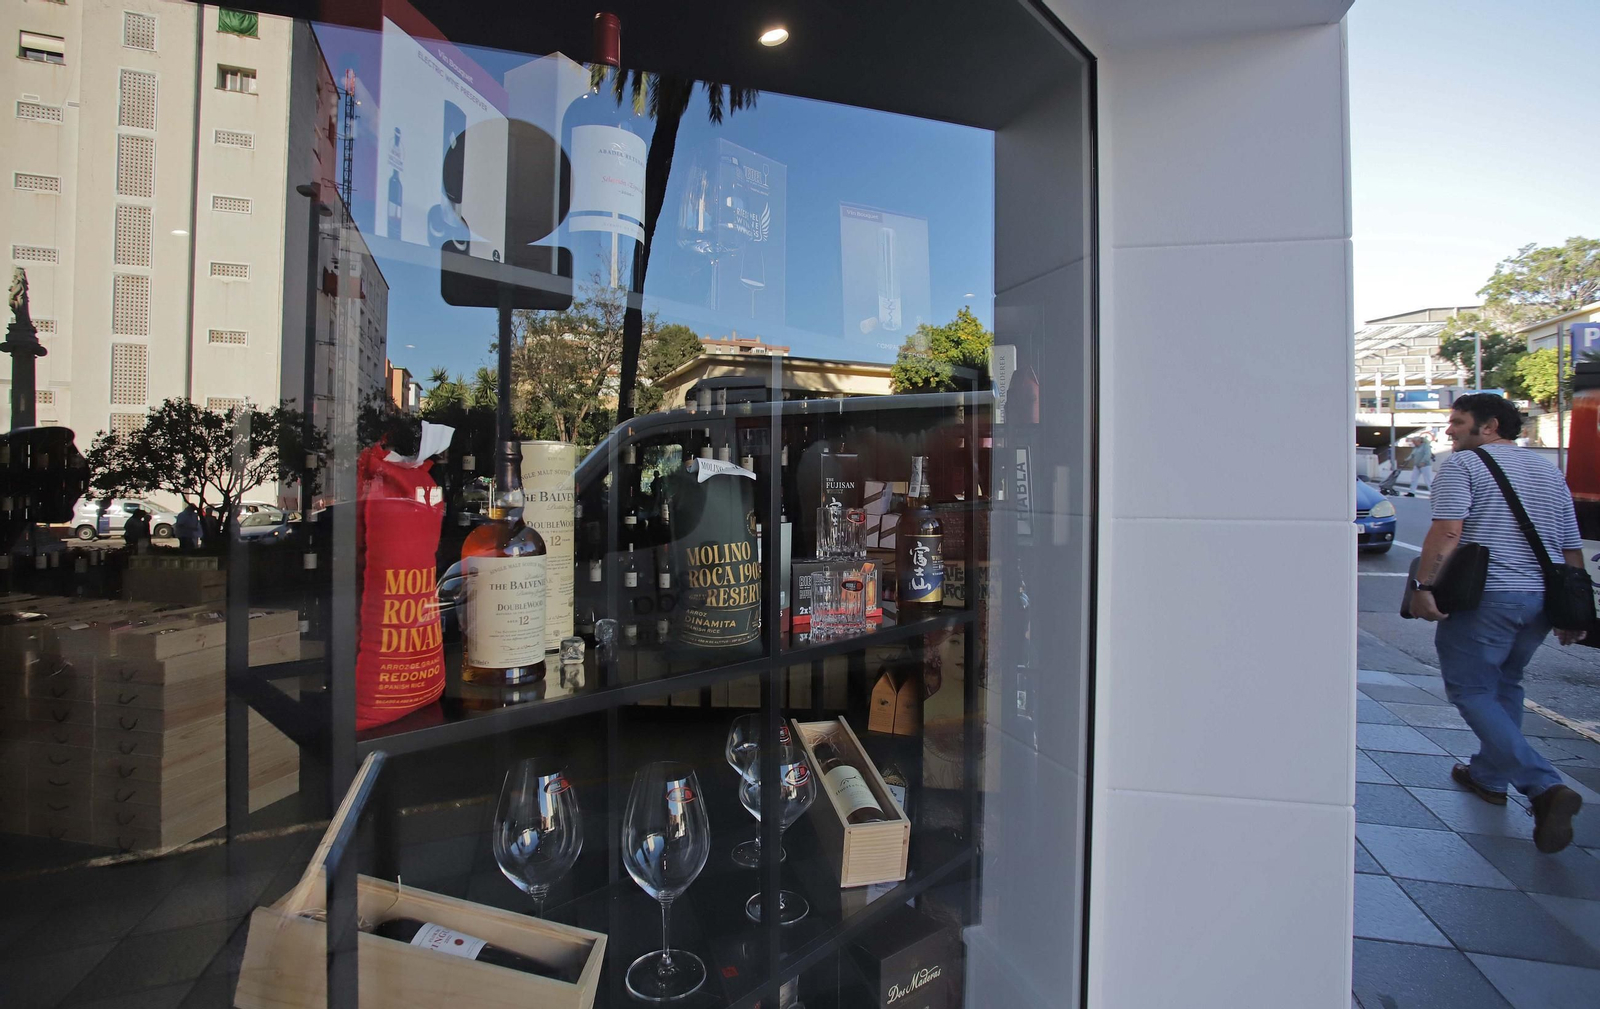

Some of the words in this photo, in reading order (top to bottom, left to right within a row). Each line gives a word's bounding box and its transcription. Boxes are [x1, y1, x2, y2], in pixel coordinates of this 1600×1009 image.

[418, 50, 444, 77] ELECTRIC
[1016, 461, 1030, 521] HABLA
[550, 536, 561, 547] 12
[686, 541, 751, 566] MOLINO
[688, 565, 736, 588] ROCA
[519, 615, 529, 625] 12
[685, 615, 736, 628] DINAMITA
[379, 665, 440, 682] REDONDO
